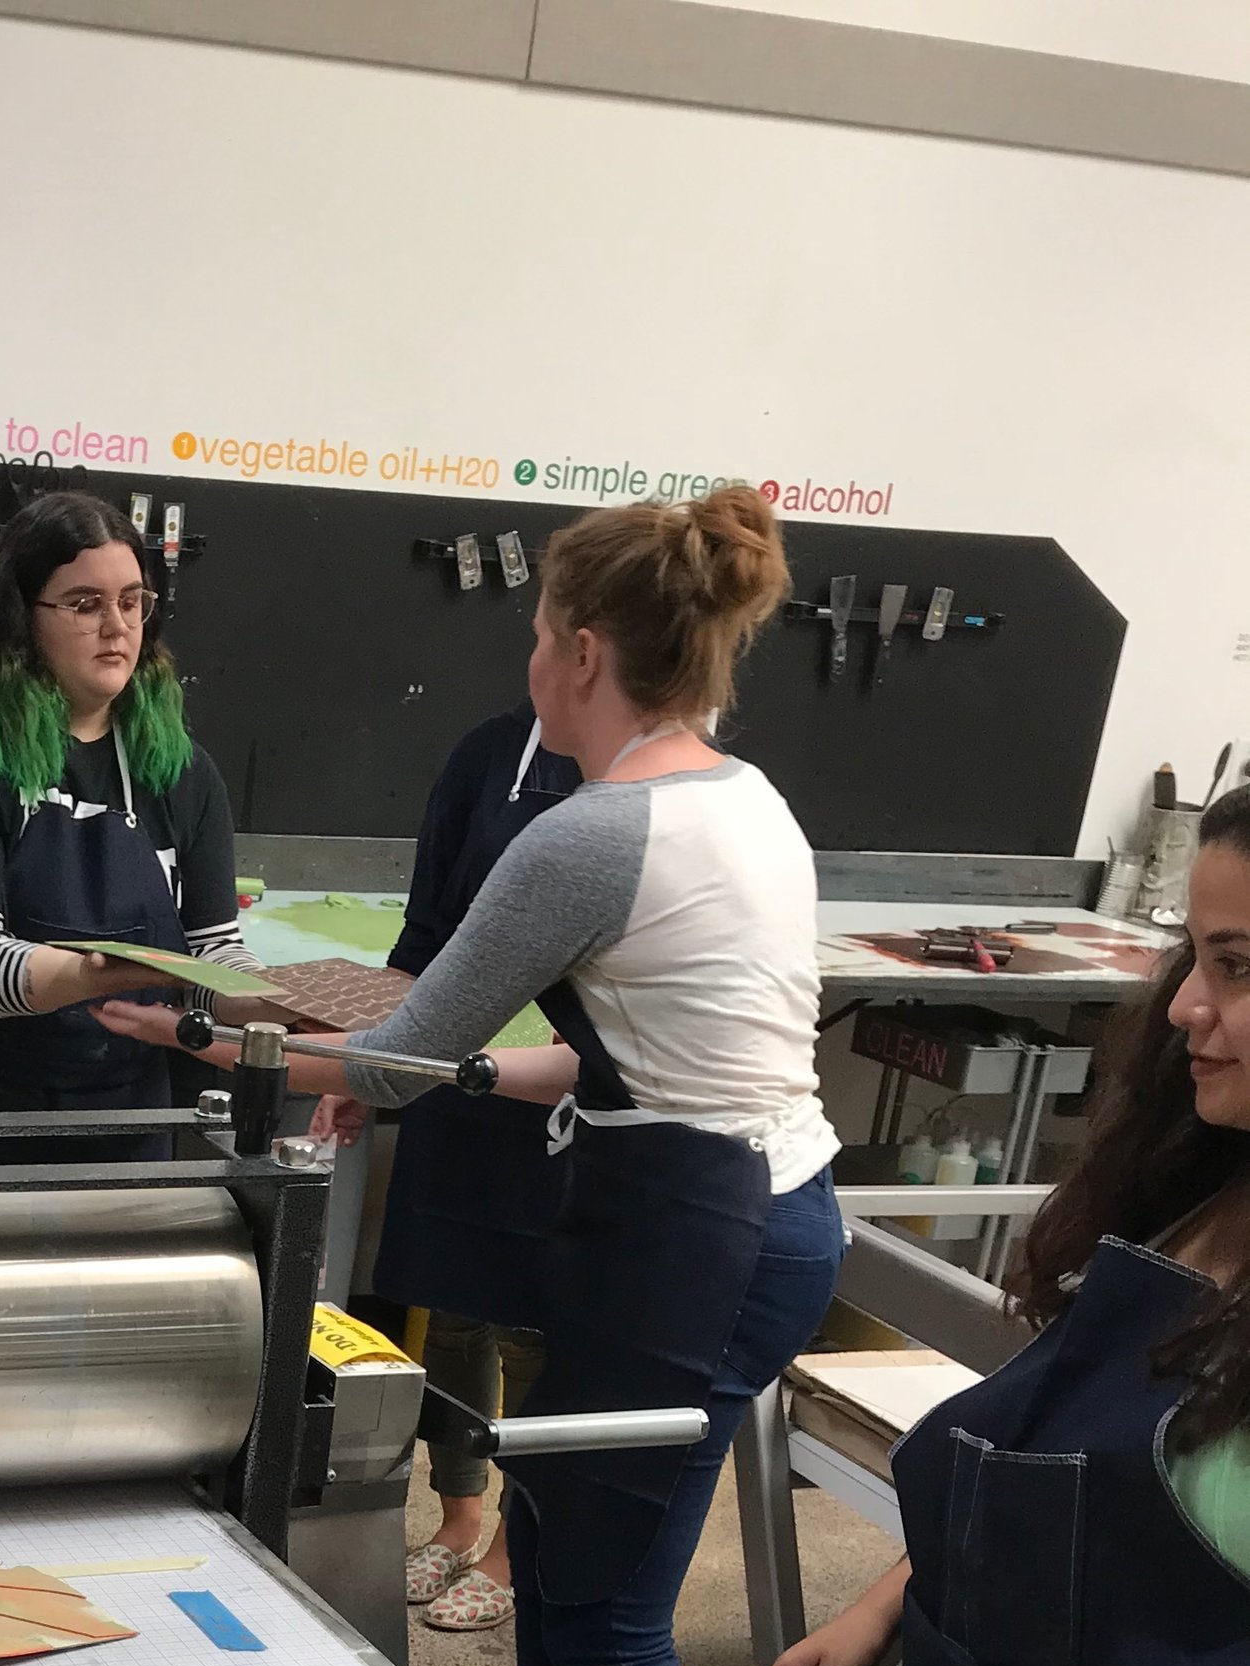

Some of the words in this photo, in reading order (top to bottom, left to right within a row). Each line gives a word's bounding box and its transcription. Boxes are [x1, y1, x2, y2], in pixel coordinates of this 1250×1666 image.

[6, 417, 39, 453] to
[52, 422, 149, 464] clean
[199, 436, 369, 478] vegetable
[543, 456, 648, 501] simple
[782, 478, 894, 516] alcohol
[867, 1022, 948, 1078] CLEAN
